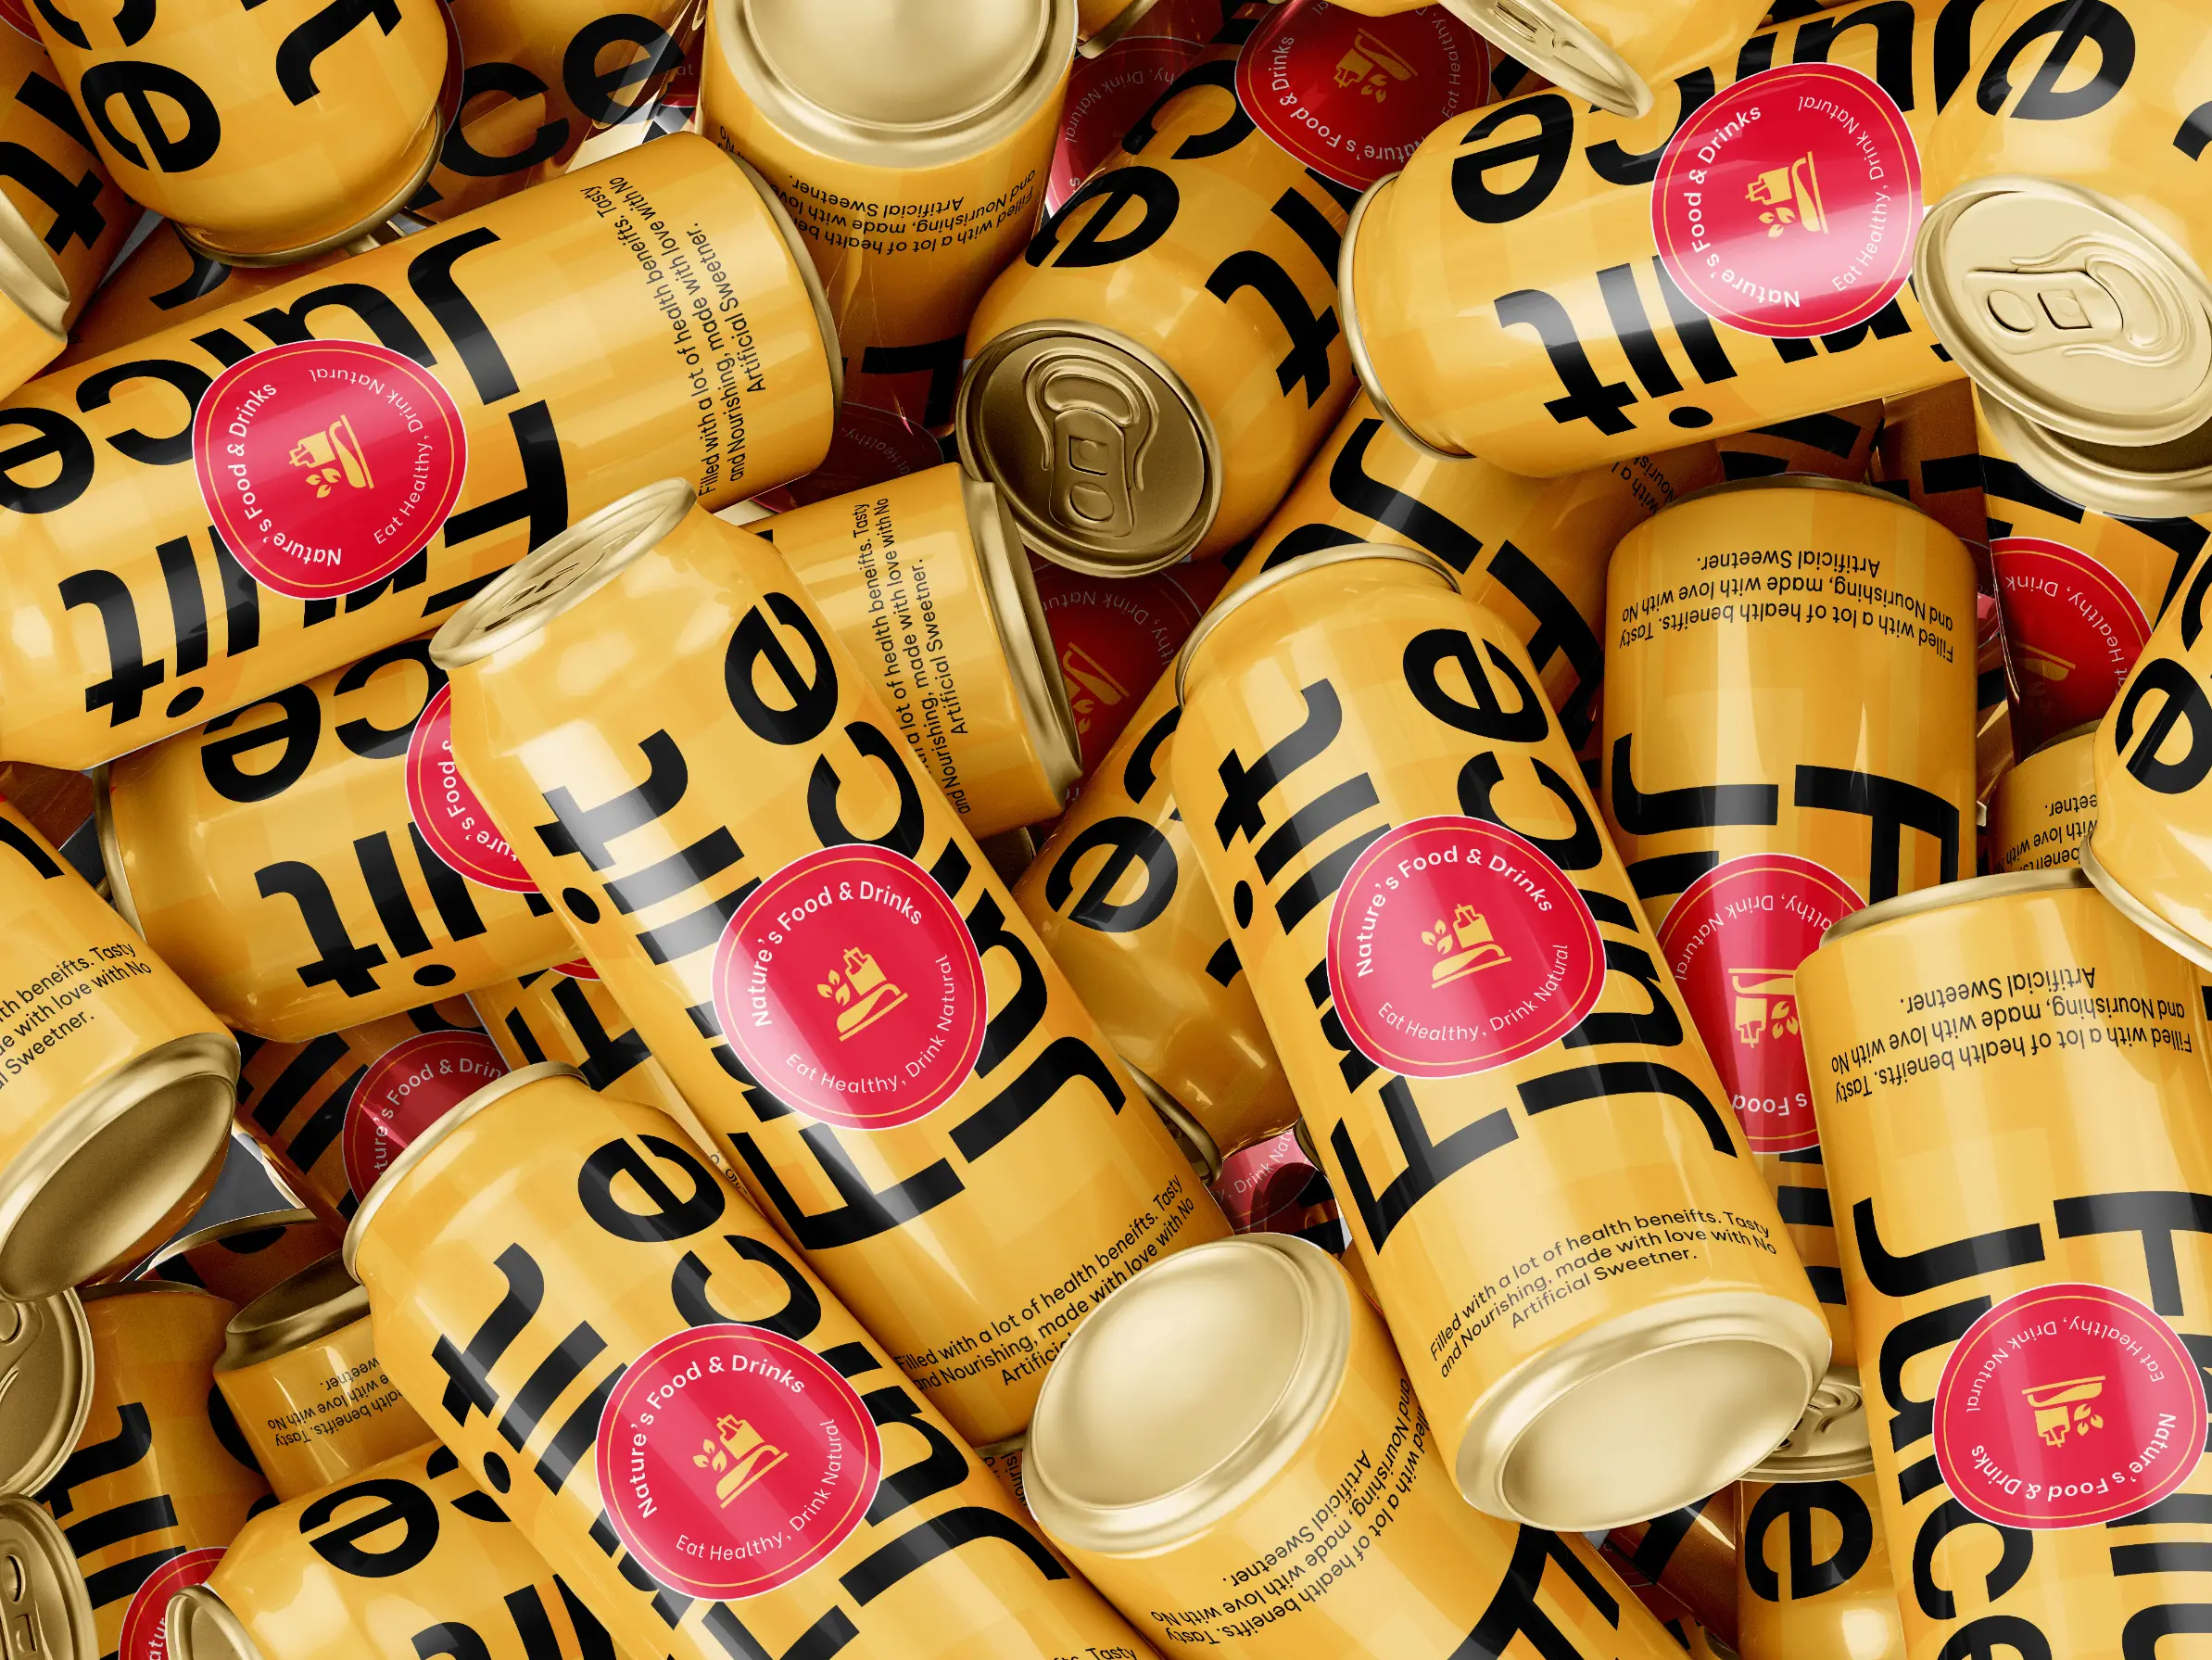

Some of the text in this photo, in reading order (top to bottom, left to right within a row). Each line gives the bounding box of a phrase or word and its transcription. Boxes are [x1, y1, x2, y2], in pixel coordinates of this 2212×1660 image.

[1102, 70, 1144, 93] Drink
[1268, 36, 1294, 91] Drinks
[1065, 87, 1101, 143] Natural
[1280, 92, 1297, 107] &
[1441, 89, 1459, 119] Eat
[1290, 108, 1342, 148] Food
[1698, 107, 1761, 164] Drinks
[789, 175, 964, 218] Artificial Sweetner.
[1688, 169, 1707, 184] &
[1798, 95, 1891, 292] Eat Healthy, Drink Natural
[1684, 192, 1711, 253] Food
[610, 177, 746, 481] and Nourishing, made with love with No
[686, 222, 765, 392] Artificial Sweetner.
[580, 185, 719, 496] Filled with a lot of health beneifts. Tasty
[229, 384, 277, 437] Drinks
[227, 443, 246, 457] &
[309, 368, 434, 545] Eat Healthy, Drink Natural
[228, 463, 262, 520] Food
[57, 399, 568, 728] Fit
[1697, 550, 1881, 578] Artificial Sweetner.
[1102, 593, 1149, 626] Drink
[2005, 577, 2124, 663] Healthy, Drink
[911, 558, 967, 734] Artificial Sweetner.
[437, 762, 465, 817] Food
[777, 886, 833, 931] Food
[839, 881, 853, 901] &
[860, 881, 922, 925] Drinks
[1397, 845, 1458, 879] Food
[1466, 848, 1482, 866] &
[1488, 855, 1552, 912] Drinks
[1674, 894, 1832, 981] althy, Drink Natural
[16, 943, 136, 1003] beneifts. Tasty
[533, 729, 966, 1251] Fit
[1214, 678, 1519, 1255] Fit
[1378, 944, 1568, 1042] Eat Healthy, Drink Natural
[1900, 968, 2095, 1016] Artificial Sweetner.
[5, 1011, 95, 1075] Sweetner.
[786, 954, 955, 1094] Eat Healthy, Drink Natural
[1831, 997, 2185, 1075] and Nourishing, made with love with No
[1960, 1037, 2026, 1063] health
[2031, 1033, 2052, 1055] of
[2058, 1030, 2084, 1049] lot
[2091, 1029, 2103, 1044] a
[2107, 1028, 2146, 1048] with
[2152, 1029, 2193, 1054] Filled
[1836, 1075, 1872, 1103] Tasty
[1874, 1051, 1954, 1085] beneifts.
[373, 1058, 512, 1175] ture's Food & Drin
[1731, 1095, 1789, 1117] Food
[1233, 1162, 1274, 1194] Drink
[894, 1174, 1182, 1371] Filled with a lot of health beneifts. Tasty
[1430, 1209, 1770, 1362] Filled with a lot of health beneifts. Tasty
[1510, 1246, 1697, 1329] Artificial Sweetner.
[1440, 1226, 1777, 1378] and Nourishing, made with love with No
[646, 1362, 702, 1410] Food
[708, 1356, 726, 1373] &
[731, 1354, 804, 1394] Drinks
[1966, 1316, 2166, 1413] Eat Healthy, Drink Natural
[276, 1409, 372, 1447] beneifts. Tasty
[676, 1419, 841, 1561] Eat Healthy, Drink Natural
[1971, 1444, 2023, 1495] Drinks
[2025, 1483, 2041, 1500] &
[2048, 1477, 2110, 1502] Food
[1222, 1450, 1371, 1588] Artificial Sweetner.
